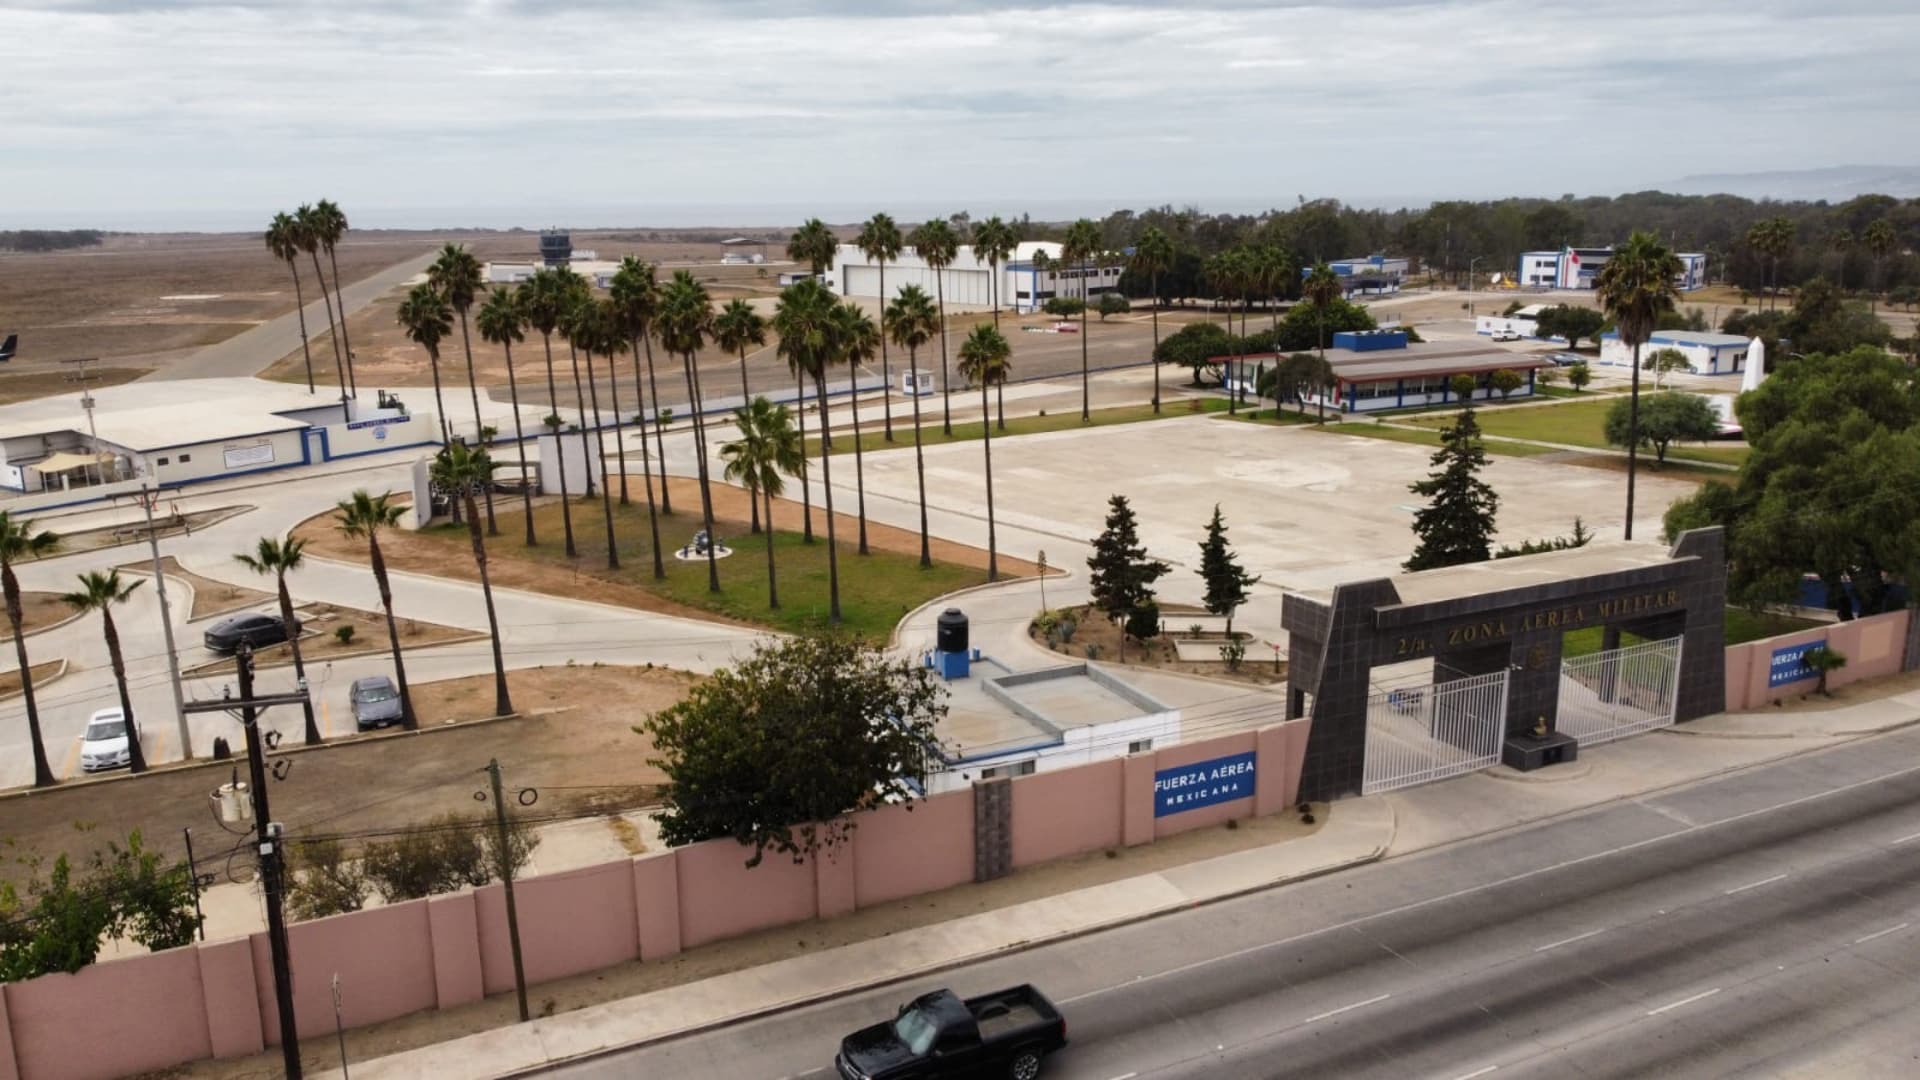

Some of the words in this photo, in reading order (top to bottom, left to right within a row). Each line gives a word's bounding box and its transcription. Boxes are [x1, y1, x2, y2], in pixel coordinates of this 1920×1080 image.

[1448, 618, 1506, 645] ZONA
[1600, 592, 1678, 617] MILITAR
[1154, 771, 1207, 792] FUERZA
[1211, 760, 1254, 780] AÉREA
[1166, 783, 1238, 806] MEXICANA
